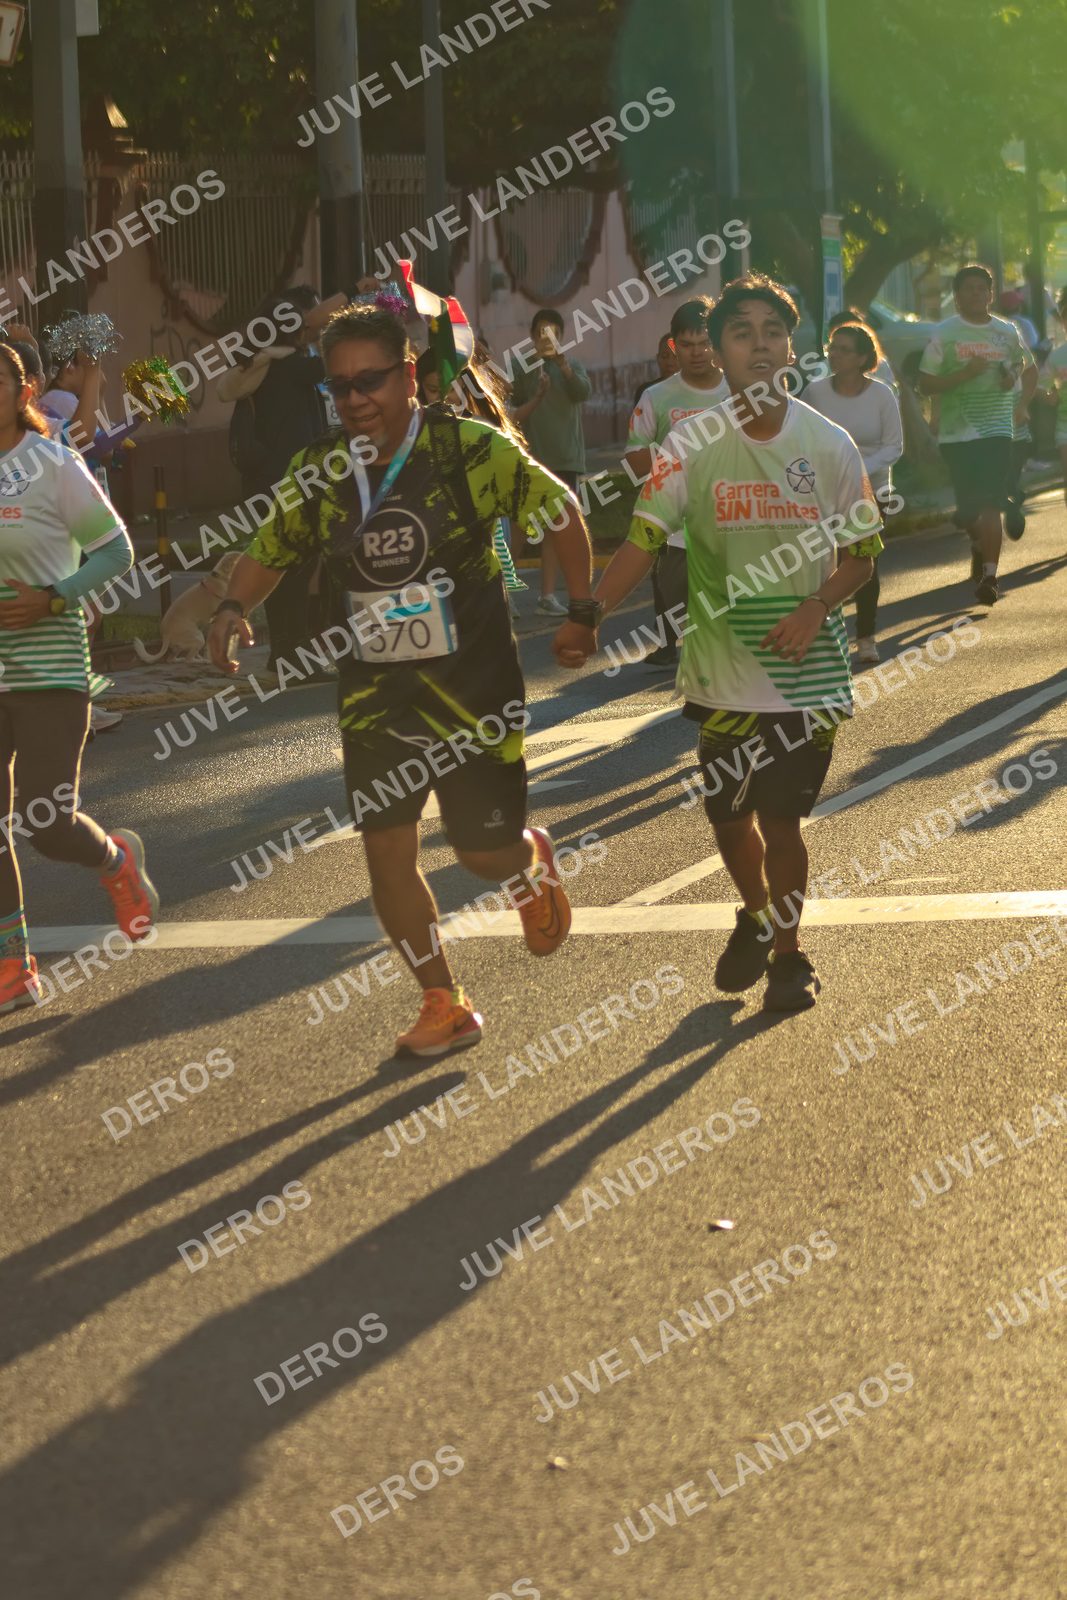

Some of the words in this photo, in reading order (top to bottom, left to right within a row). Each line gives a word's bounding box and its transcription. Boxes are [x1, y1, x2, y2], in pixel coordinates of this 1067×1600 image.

[715, 481, 781, 500] Carrera
[716, 500, 752, 522] SIN
[757, 500, 820, 521] límites
[362, 526, 415, 558] R23
[372, 555, 410, 568] RUNNERS
[369, 618, 431, 654] 570
